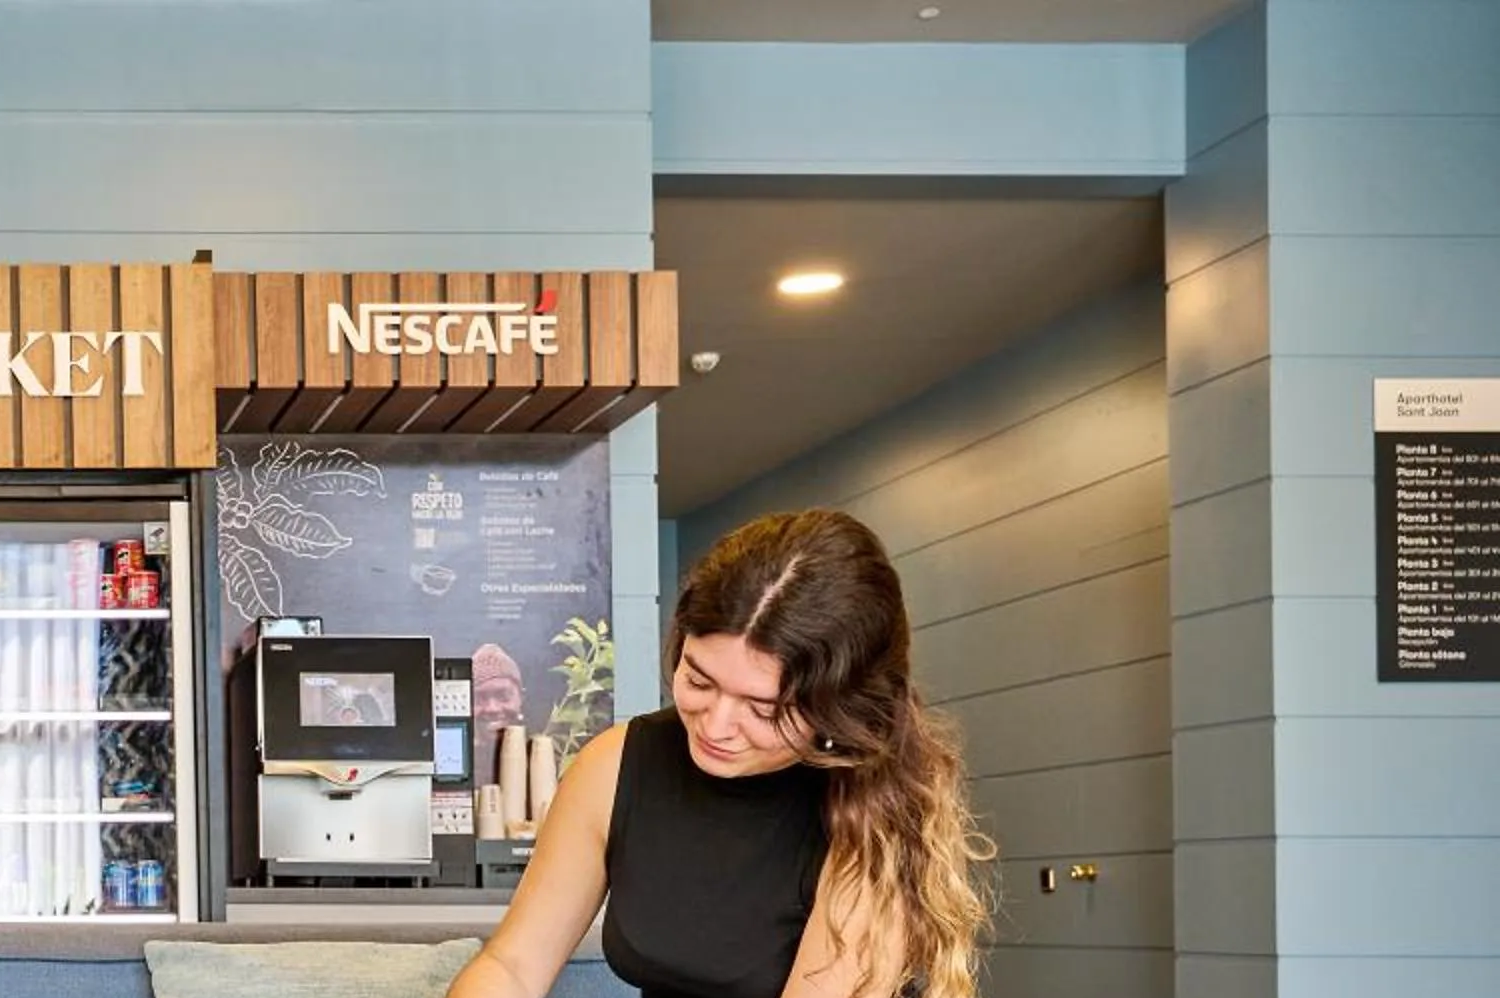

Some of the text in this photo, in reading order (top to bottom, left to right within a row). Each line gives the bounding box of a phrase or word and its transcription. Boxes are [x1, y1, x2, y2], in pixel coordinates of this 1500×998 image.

[327, 289, 560, 355] NESCAFÉ
[1397, 391, 1463, 404] Aparthotel
[1397, 405, 1459, 416] Sant Joan
[1396, 444, 1429, 455] Planta
[536, 471, 559, 481] Café
[1396, 468, 1429, 477] Planta
[1430, 468, 1437, 477] 7
[1397, 490, 1429, 500] Planta
[412, 493, 463, 509] RESPETO
[1397, 513, 1429, 523] Planta
[1397, 535, 1429, 546] Planta
[1397, 558, 1429, 568] Planta
[1397, 581, 1429, 591] Planta
[1397, 603, 1429, 614] Planta
[1431, 603, 1437, 614] 1
[1398, 627, 1455, 639] Planta baja
[1398, 649, 1430, 660] Planta
